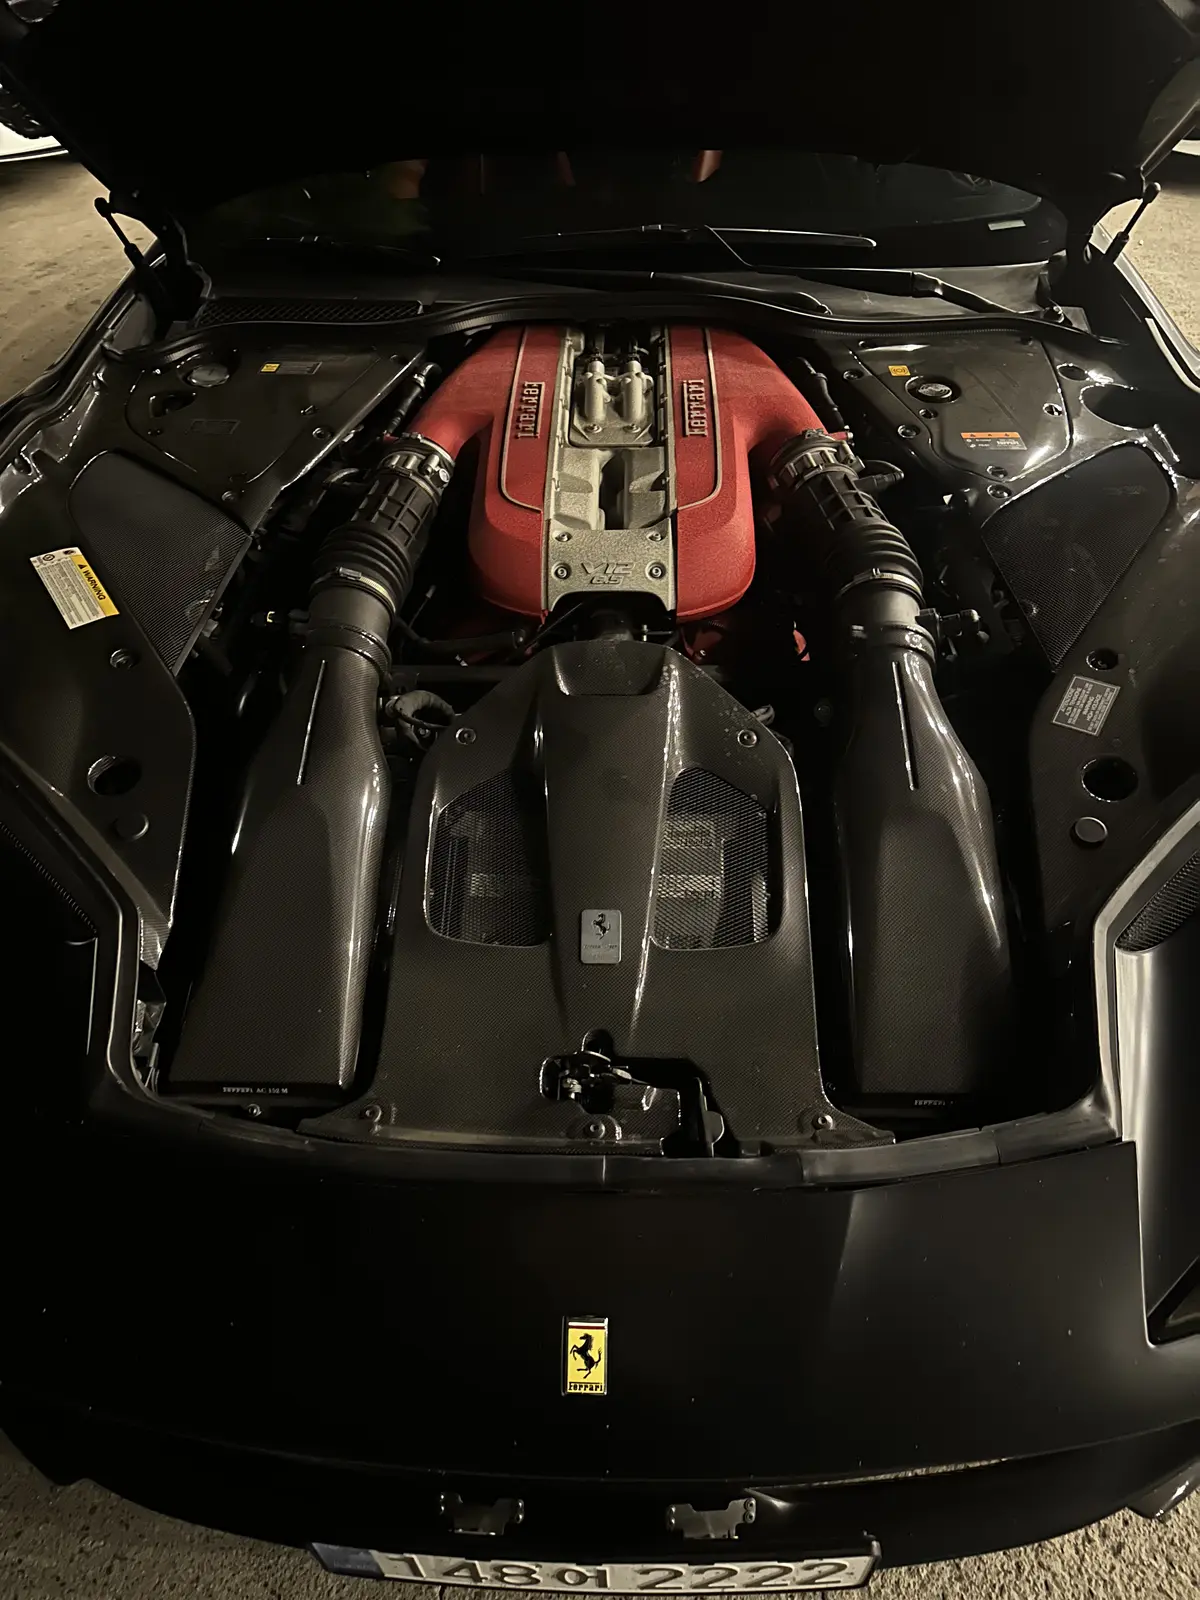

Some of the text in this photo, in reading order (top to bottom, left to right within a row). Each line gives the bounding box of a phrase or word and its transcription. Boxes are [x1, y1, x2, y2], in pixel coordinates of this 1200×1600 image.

[515, 381, 545, 440] Ferrari
[682, 378, 708, 437] Ferrari
[581, 562, 635, 575] V12
[83, 569, 106, 601] WARNING
[568, 1381, 603, 1392] Ferrari
[637, 1562, 848, 1590] 2222
